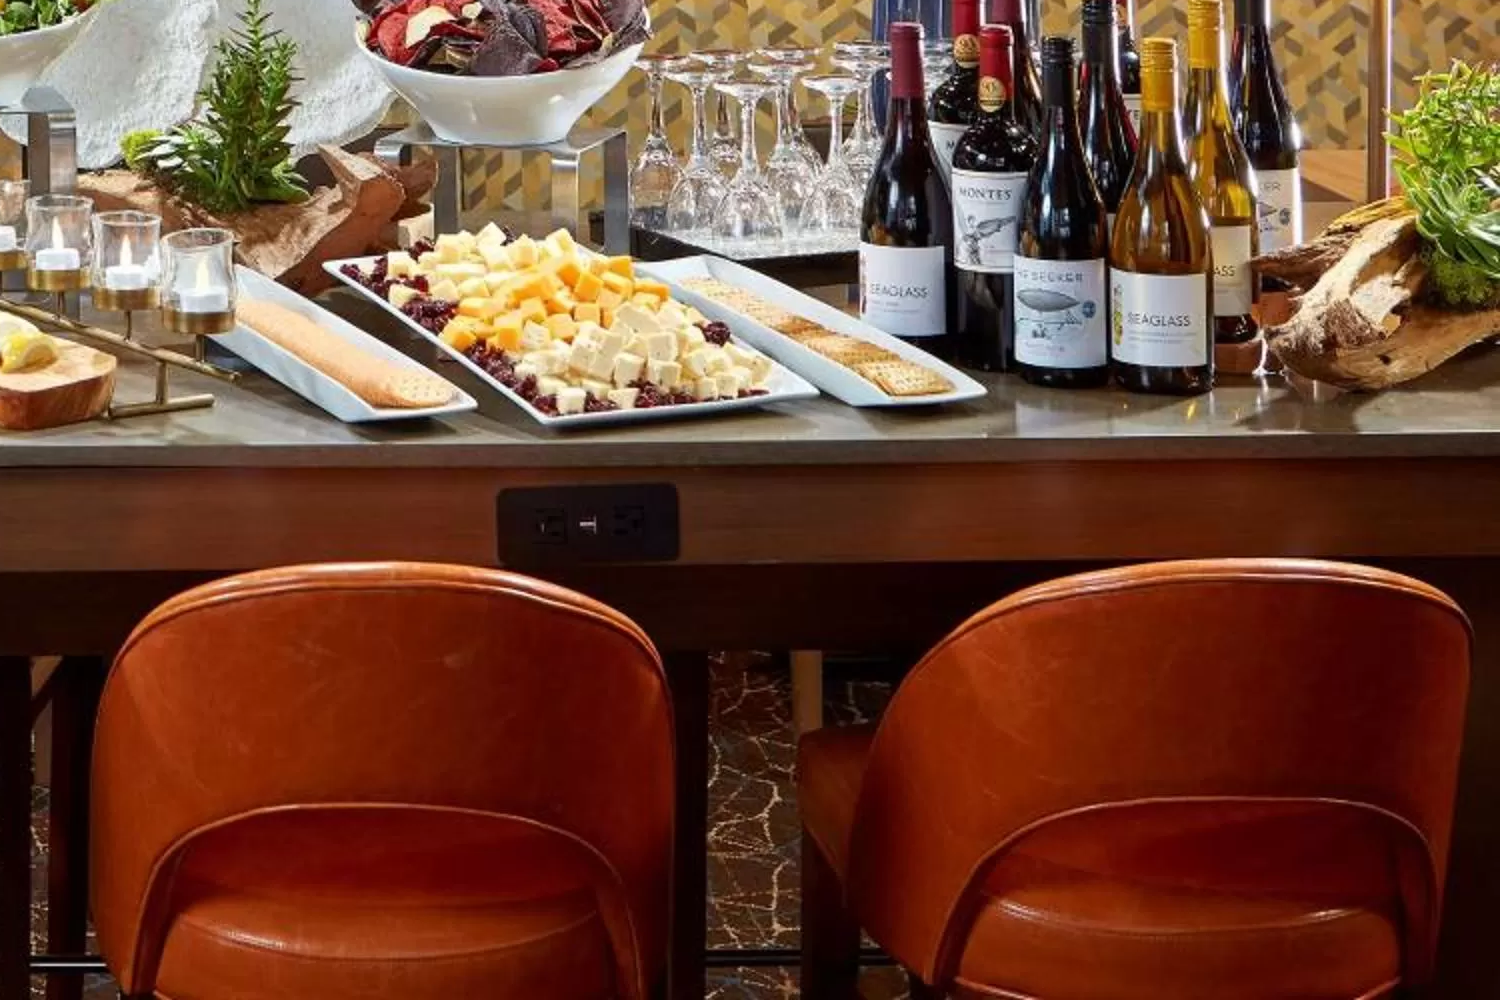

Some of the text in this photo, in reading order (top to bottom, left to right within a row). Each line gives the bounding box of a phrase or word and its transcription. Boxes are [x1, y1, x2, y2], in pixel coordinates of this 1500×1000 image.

[959, 186, 1013, 201] MONTES
[870, 283, 929, 299] SEAGLASS
[1126, 311, 1192, 327] SEAGLASS
